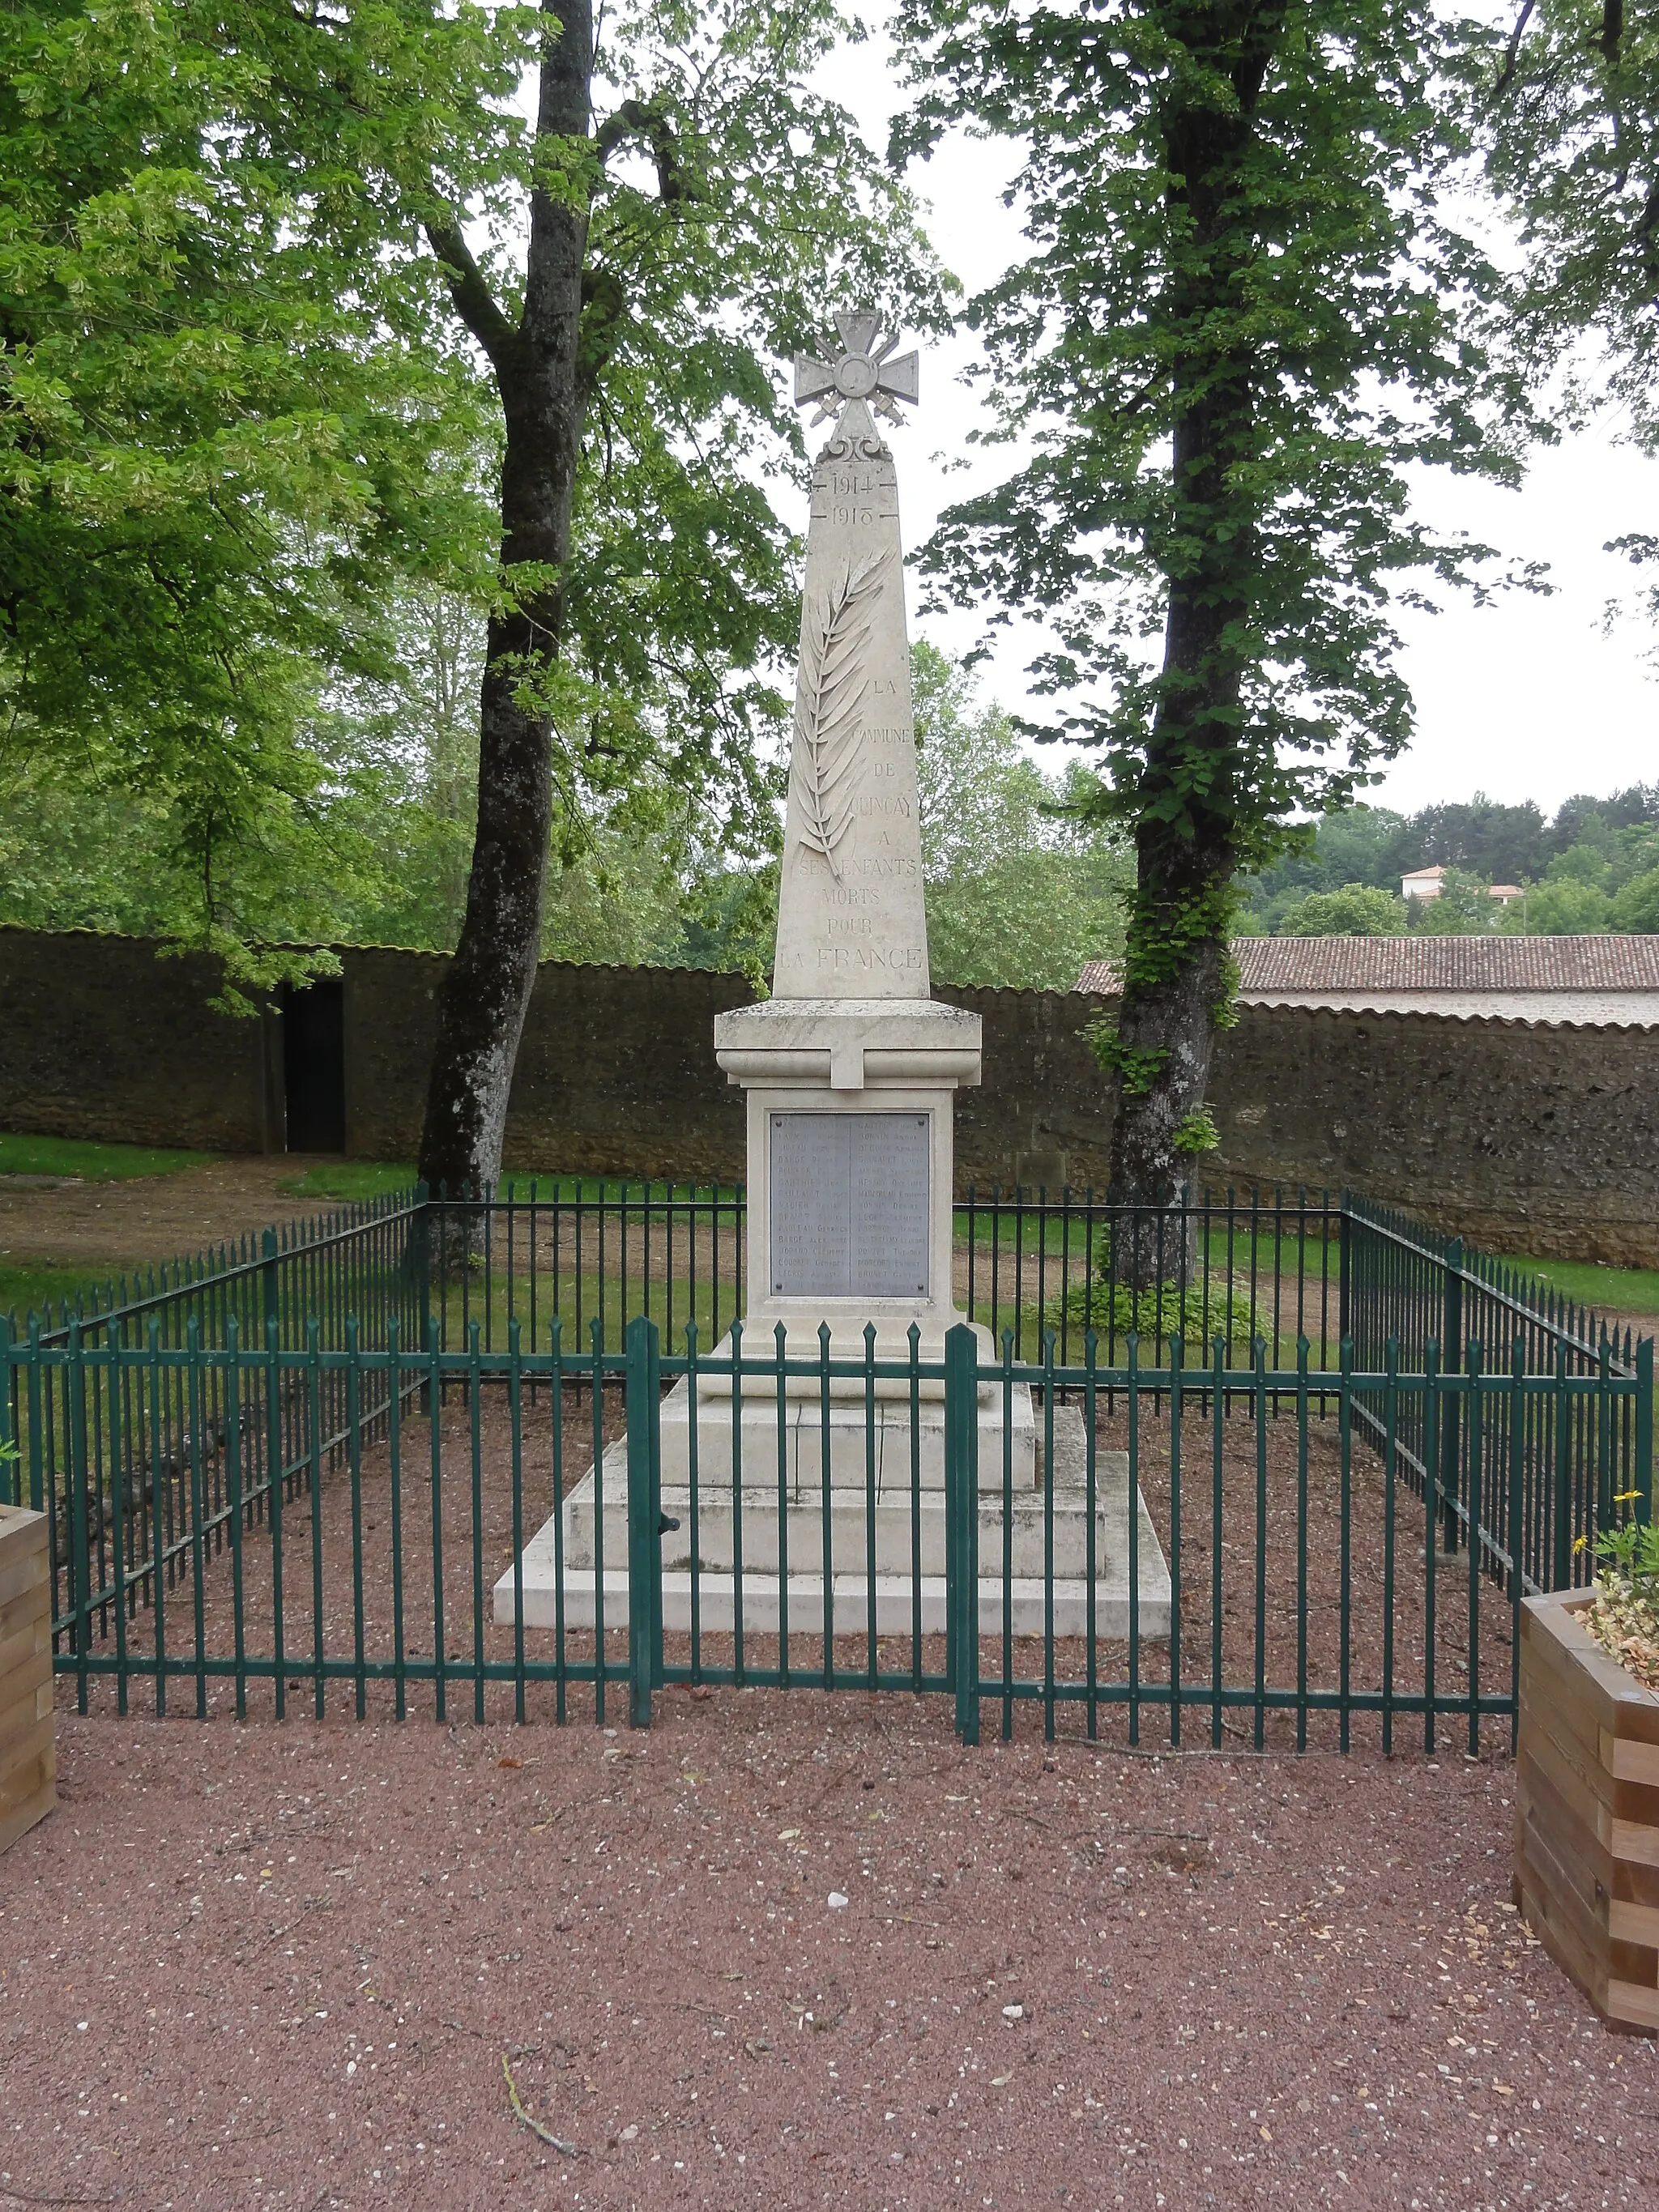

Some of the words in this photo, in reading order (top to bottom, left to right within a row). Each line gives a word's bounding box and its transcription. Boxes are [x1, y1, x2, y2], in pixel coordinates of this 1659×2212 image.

[832, 475, 873, 494] 1914
[832, 507, 873, 525] 1918
[874, 680, 897, 693] LA
[852, 729, 910, 743] COMMUNE
[873, 763, 895, 777] DE
[878, 830, 891, 845] A
[799, 859, 830, 876] SES
[839, 859, 917, 876] ENFANTS
[822, 889, 881, 905] MORTS
[826, 918, 872, 935] POUR
[779, 953, 804, 969] LA
[817, 948, 923, 970] FRANCE
